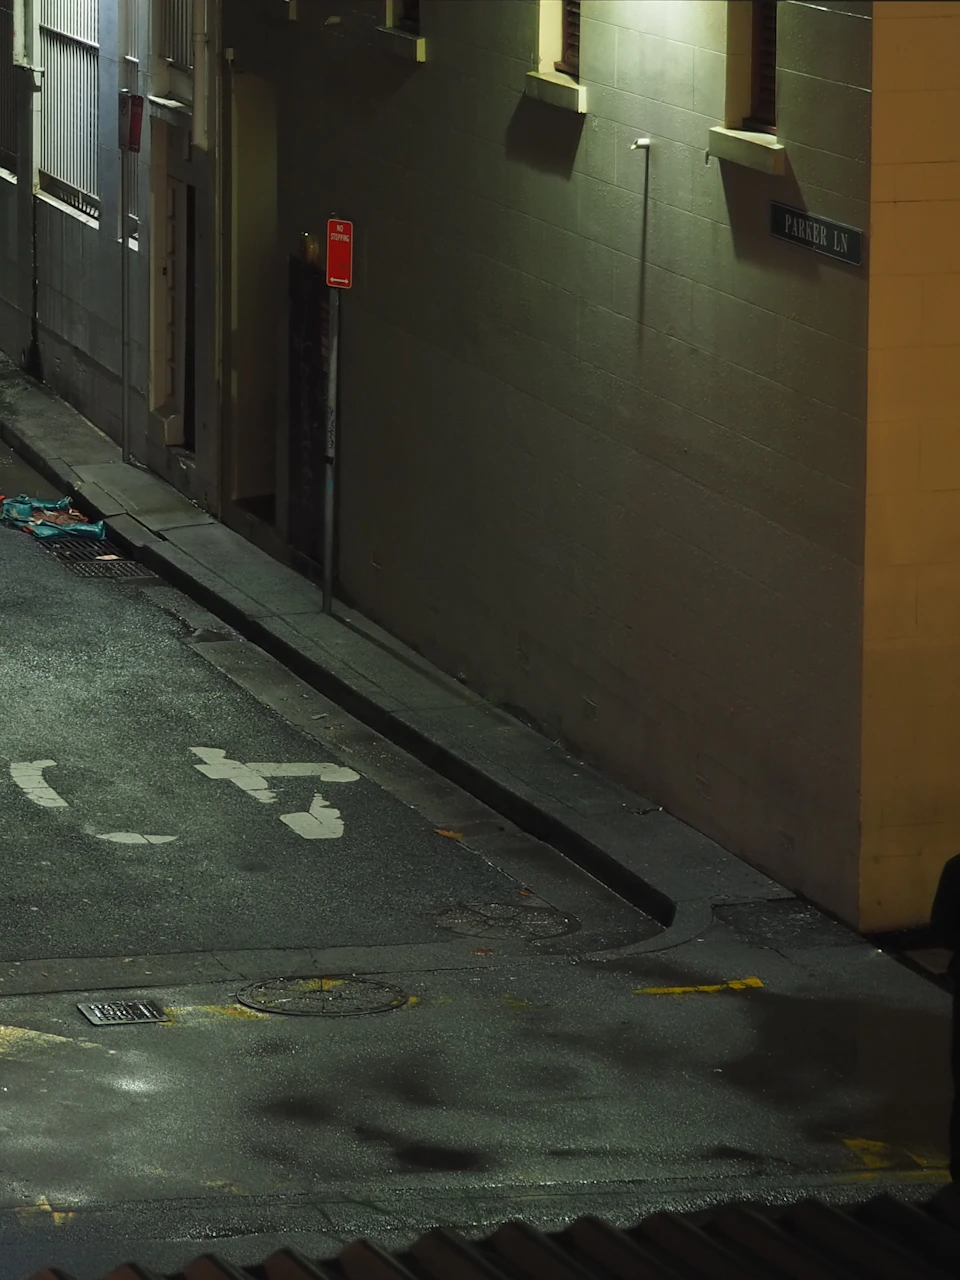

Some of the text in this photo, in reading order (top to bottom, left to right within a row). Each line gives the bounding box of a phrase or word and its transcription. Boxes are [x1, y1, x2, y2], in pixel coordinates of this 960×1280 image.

[336, 224, 344, 232] NO
[330, 233, 350, 243] STOPPING
[785, 214, 848, 253] PARKER LN
